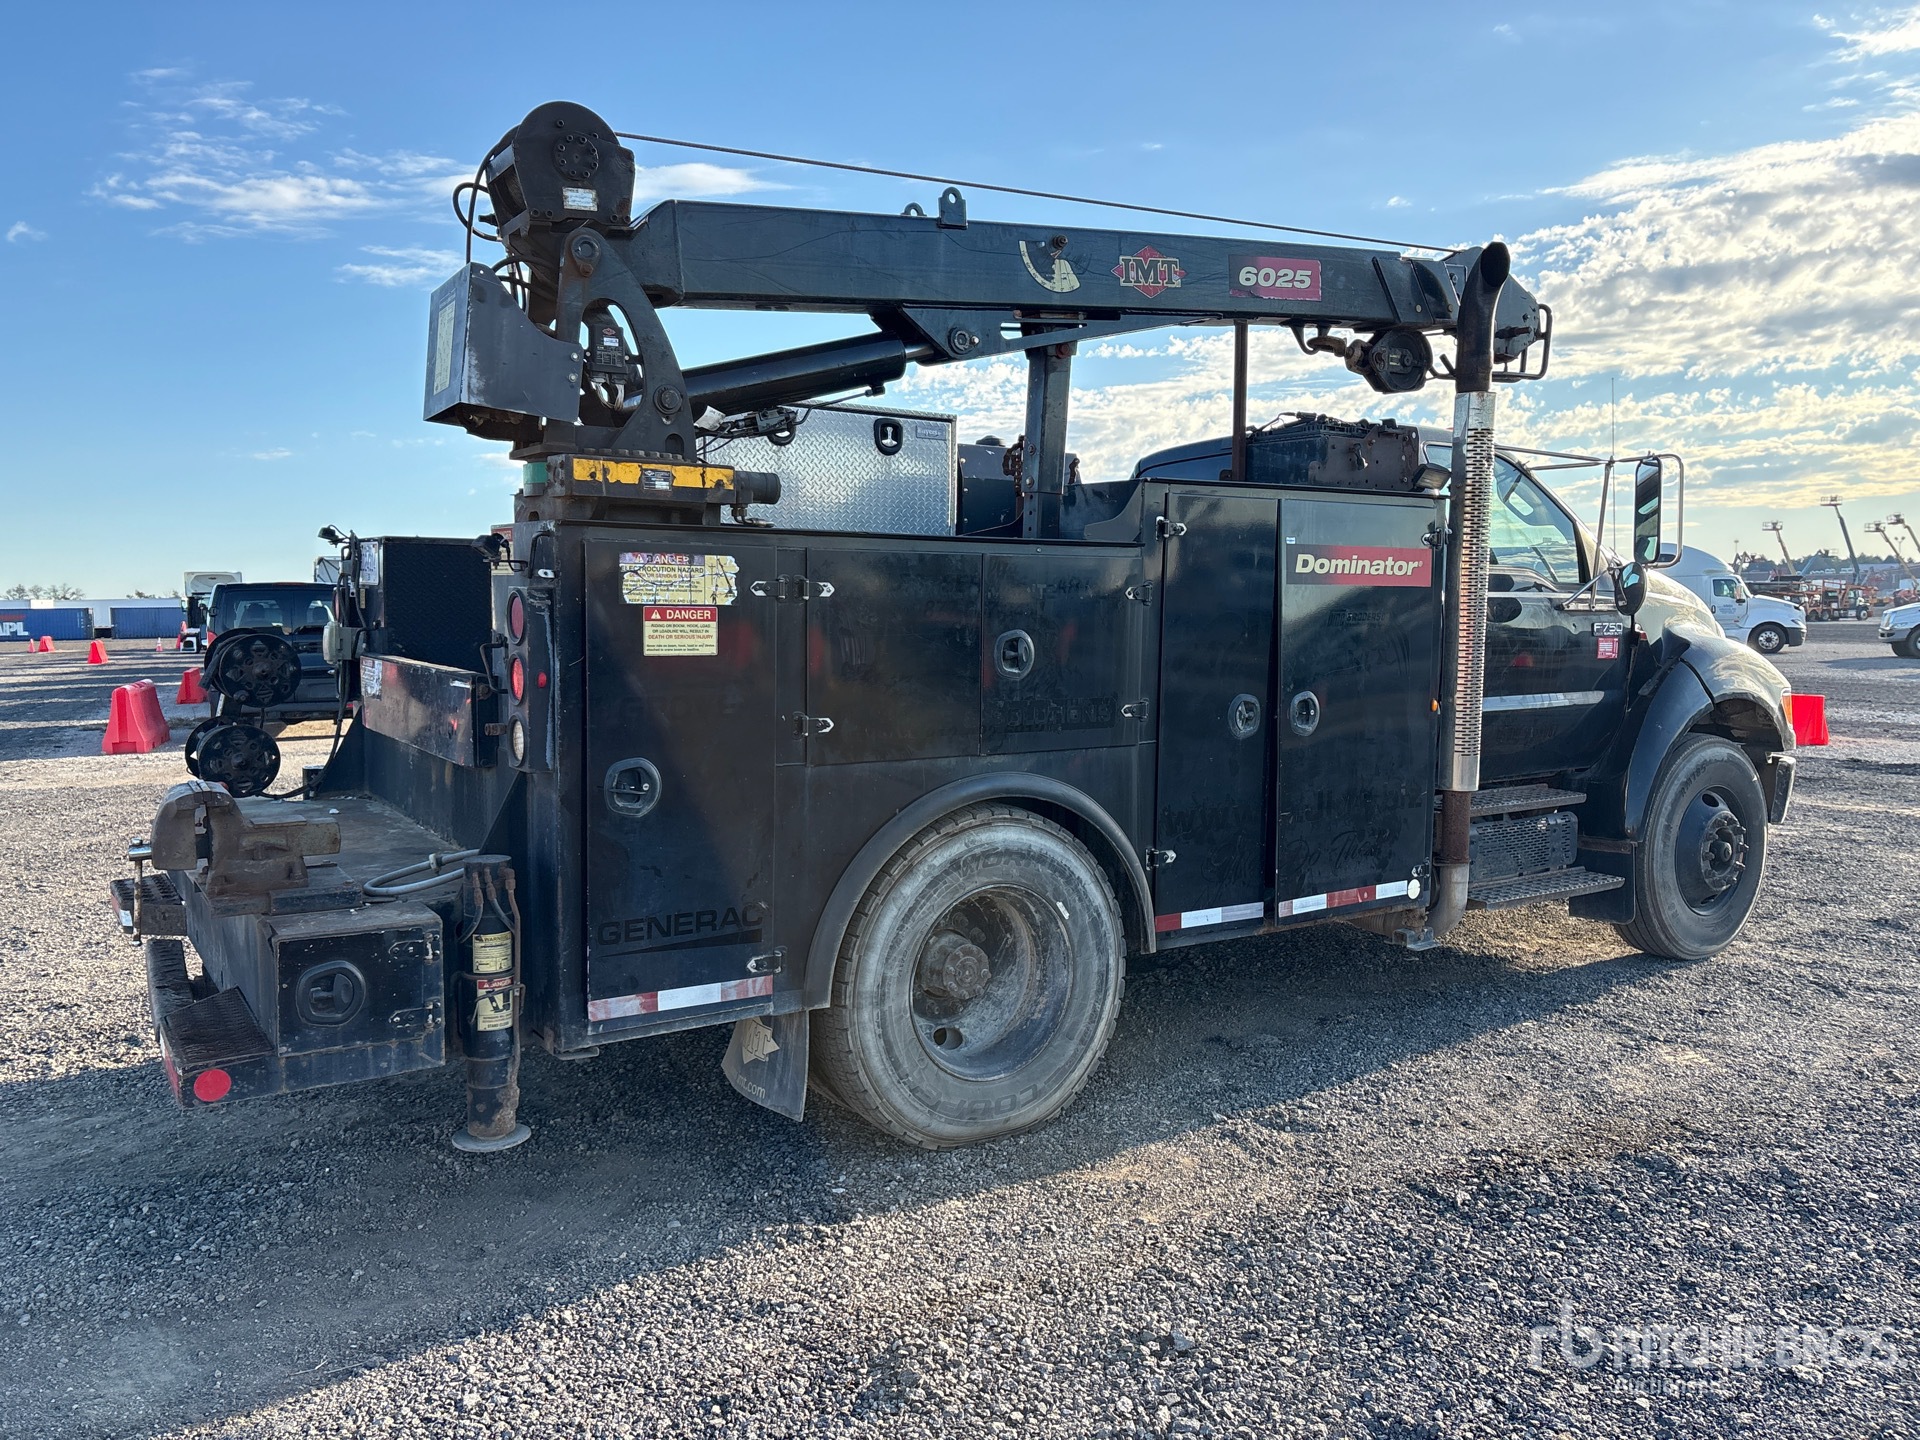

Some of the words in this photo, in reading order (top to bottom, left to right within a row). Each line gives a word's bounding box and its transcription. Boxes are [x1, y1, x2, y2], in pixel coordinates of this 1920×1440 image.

[1120, 256, 1181, 287] IMT
[1238, 266, 1312, 289] 6025
[677, 566, 704, 574] HAZARD
[666, 609, 711, 620] DANGER
[1594, 622, 1623, 632] F750
[597, 903, 764, 946] GENERAC
